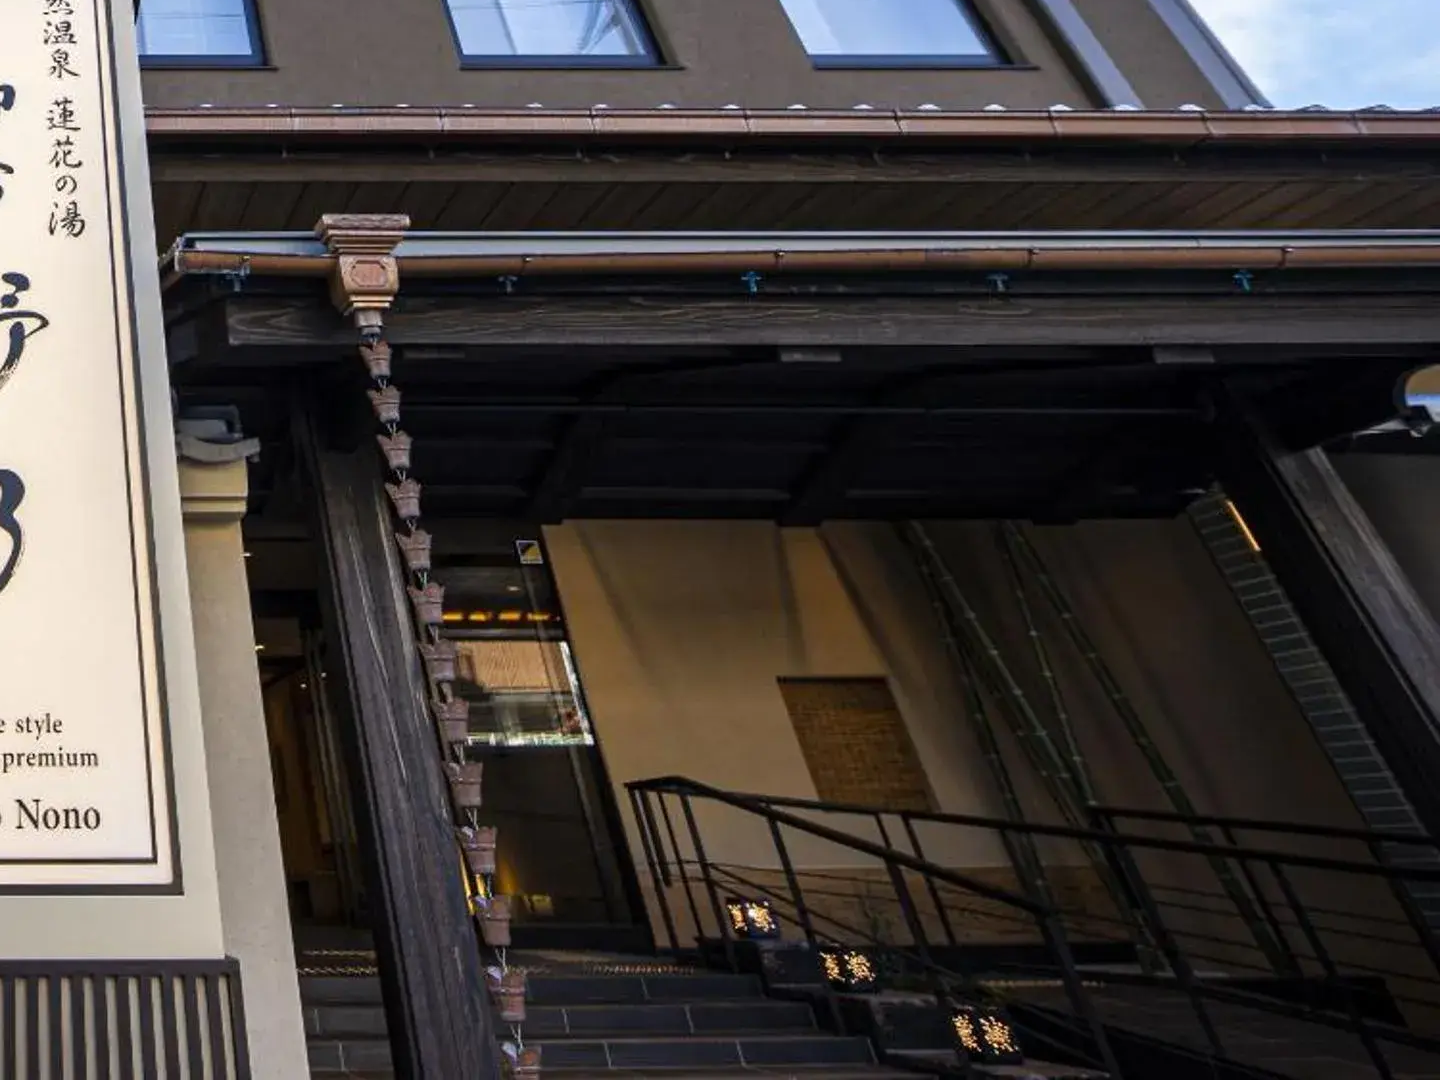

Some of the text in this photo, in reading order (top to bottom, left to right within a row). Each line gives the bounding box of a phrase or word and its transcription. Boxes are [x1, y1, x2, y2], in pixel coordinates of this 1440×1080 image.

[46, 97, 86, 238] 蓮花の湯
[15, 712, 63, 740] style
[2, 746, 99, 773] premium
[14, 798, 101, 831] Nono
